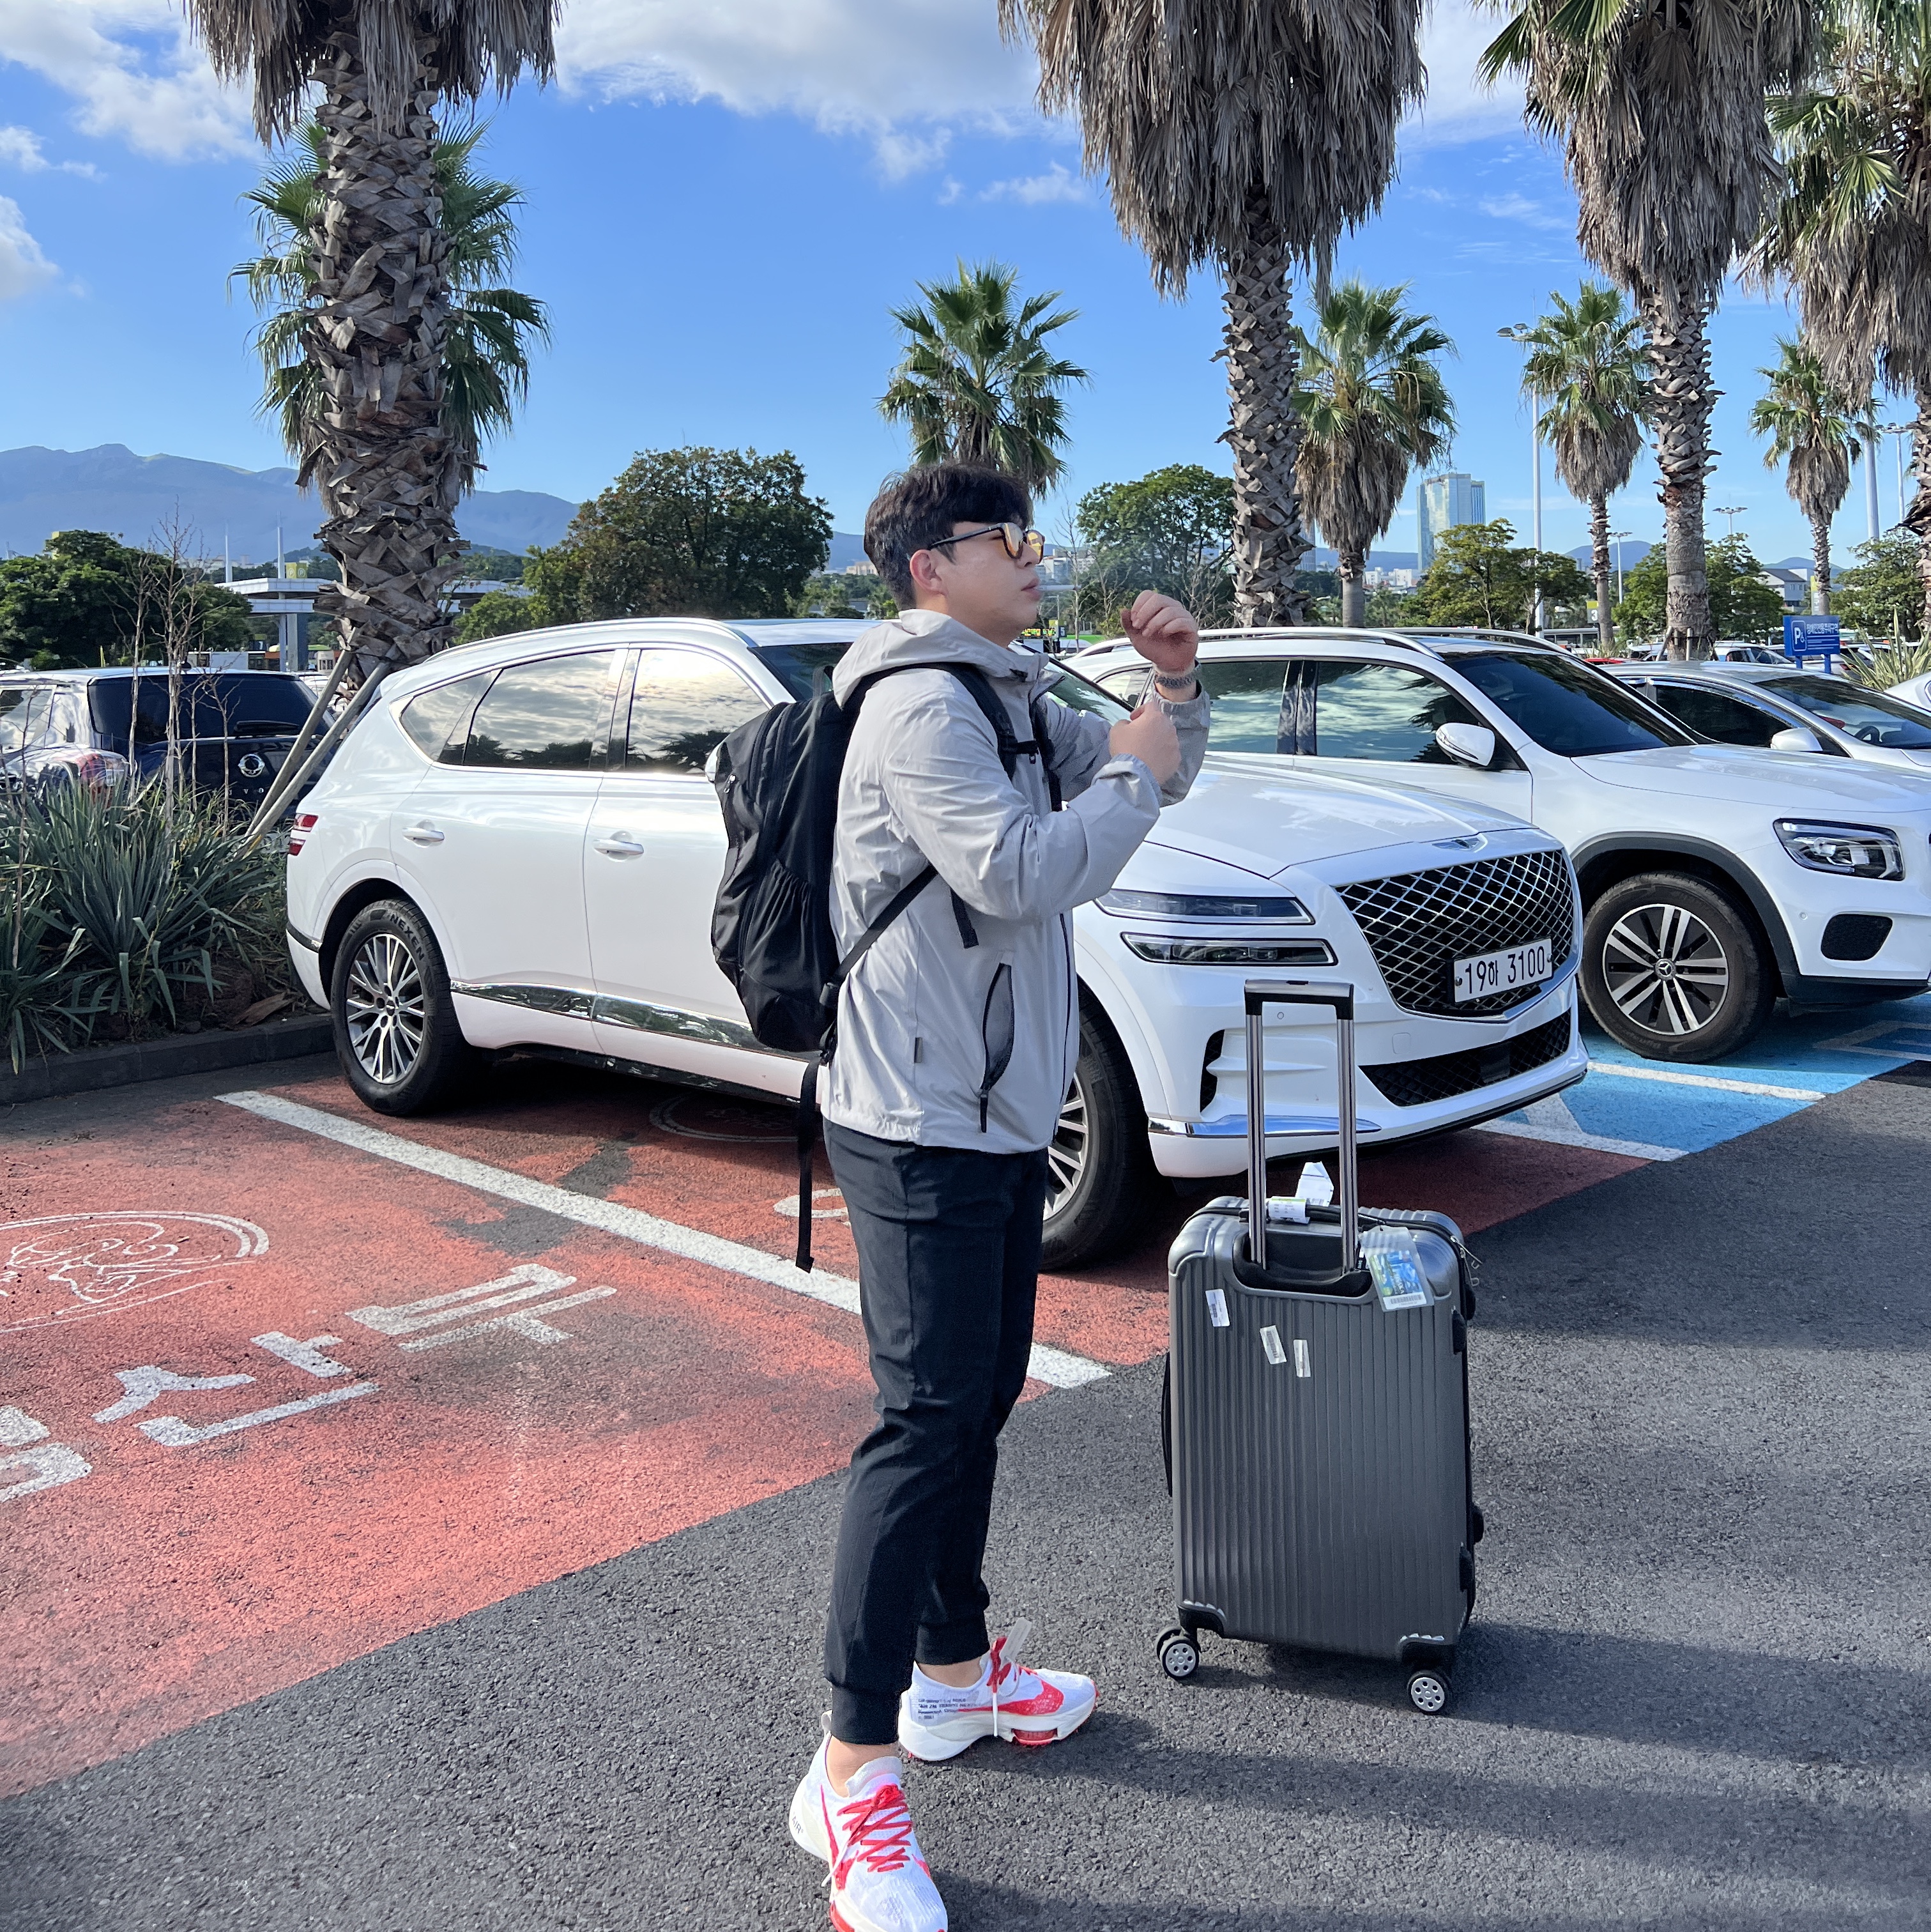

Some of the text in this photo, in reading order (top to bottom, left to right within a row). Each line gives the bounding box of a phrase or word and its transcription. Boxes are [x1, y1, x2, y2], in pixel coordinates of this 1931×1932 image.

[1591, 610, 1598, 621] 3
[1060, 627, 1065, 636] 5
[1794, 627, 1801, 645] P
[390, 914, 425, 960] NEXEN
[1465, 946, 1545, 994] 19하 3100
